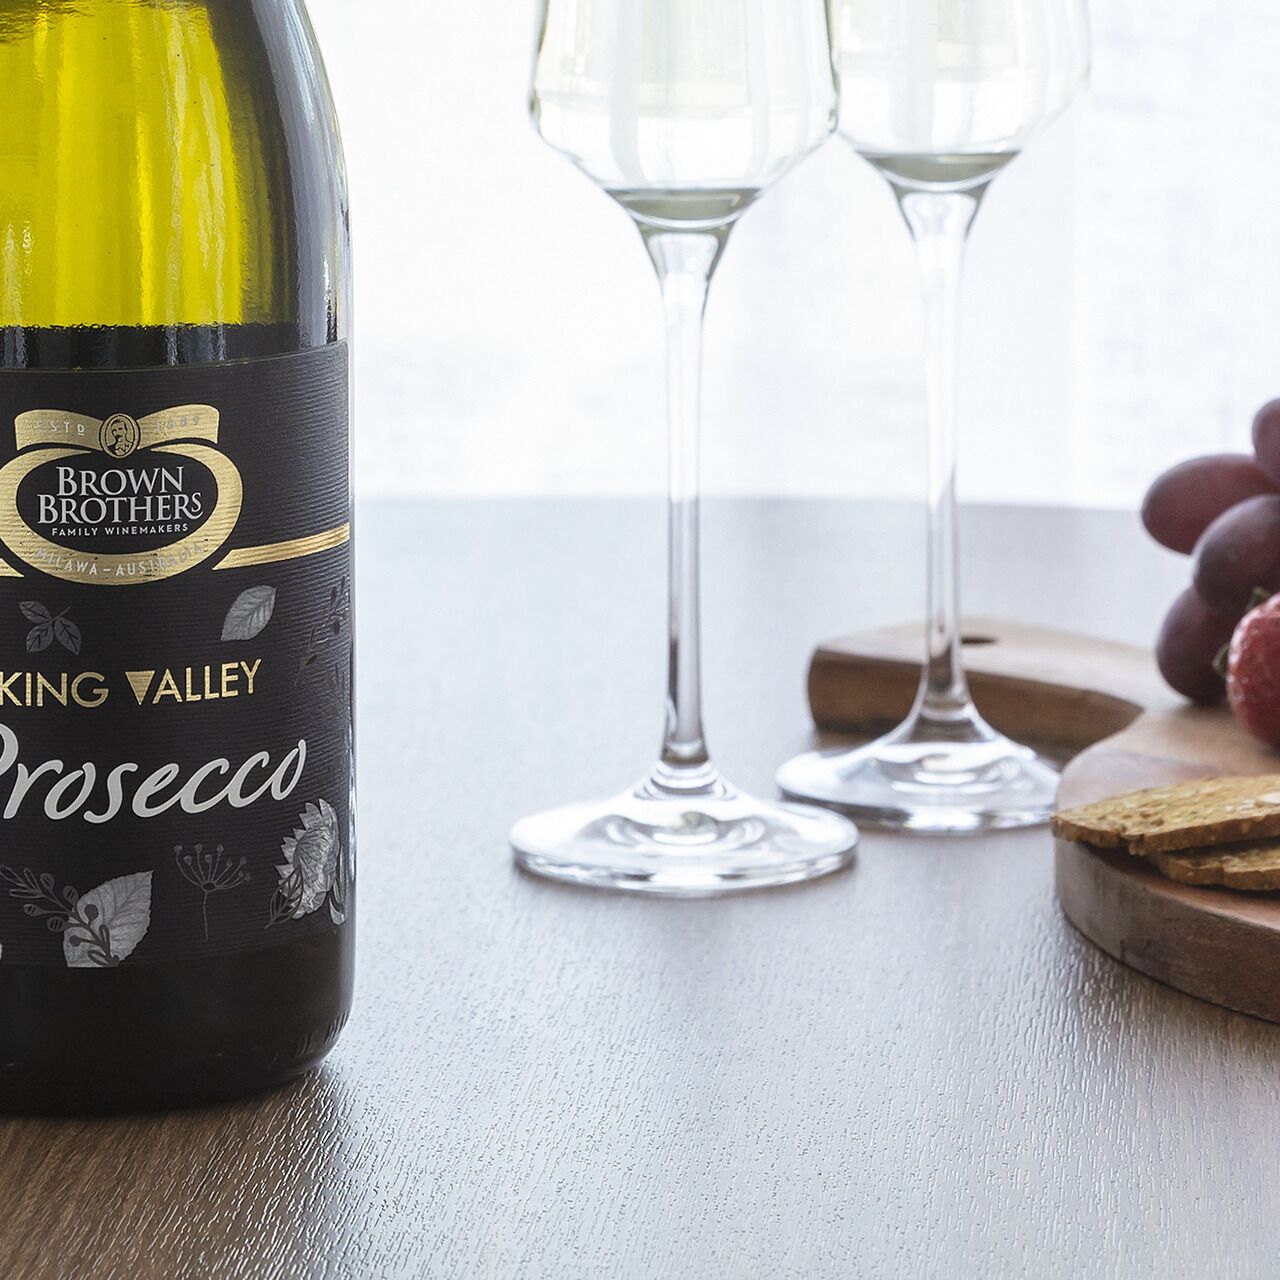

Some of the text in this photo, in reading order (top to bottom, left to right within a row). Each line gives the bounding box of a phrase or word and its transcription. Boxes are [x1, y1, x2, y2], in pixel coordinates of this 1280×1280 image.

[56, 466, 184, 497] BROWN
[37, 492, 203, 524] BROTHERS
[52, 523, 189, 536] FAMILY WINEMAKERS
[125, 658, 263, 706] VALLEY
